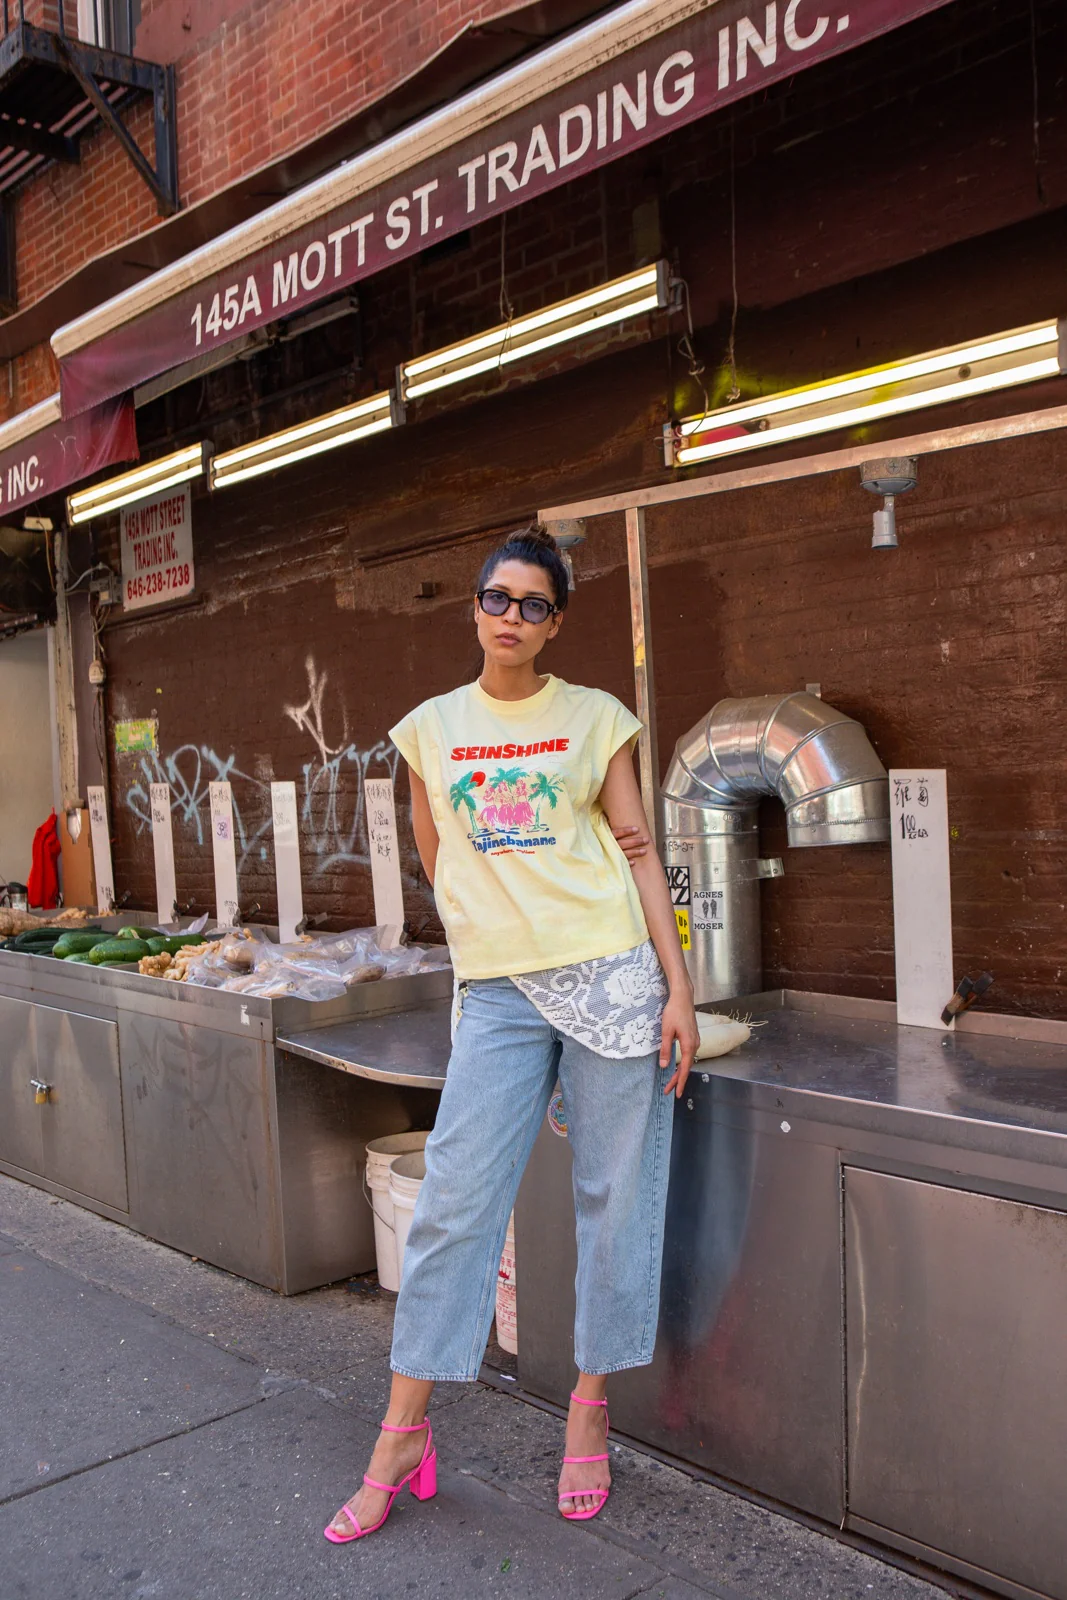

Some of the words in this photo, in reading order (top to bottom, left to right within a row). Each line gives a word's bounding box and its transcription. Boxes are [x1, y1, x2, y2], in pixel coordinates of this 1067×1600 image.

[190, 274, 263, 347] 145A
[271, 211, 374, 308] MOTT
[384, 178, 444, 251] ST.
[457, 49, 696, 214] TRADING
[717, 0, 850, 91] INC.
[7, 454, 44, 503] INC.
[125, 511, 140, 542] 145A
[140, 504, 158, 536] MOTT
[159, 494, 186, 530] STREET
[133, 535, 163, 571] TRADING
[163, 531, 179, 562] INC.
[127, 563, 190, 600] 646-238-7238
[450, 738, 570, 761] SEINSHINE
[693, 890, 724, 899] AGNES
[694, 922, 724, 930] MOSER
